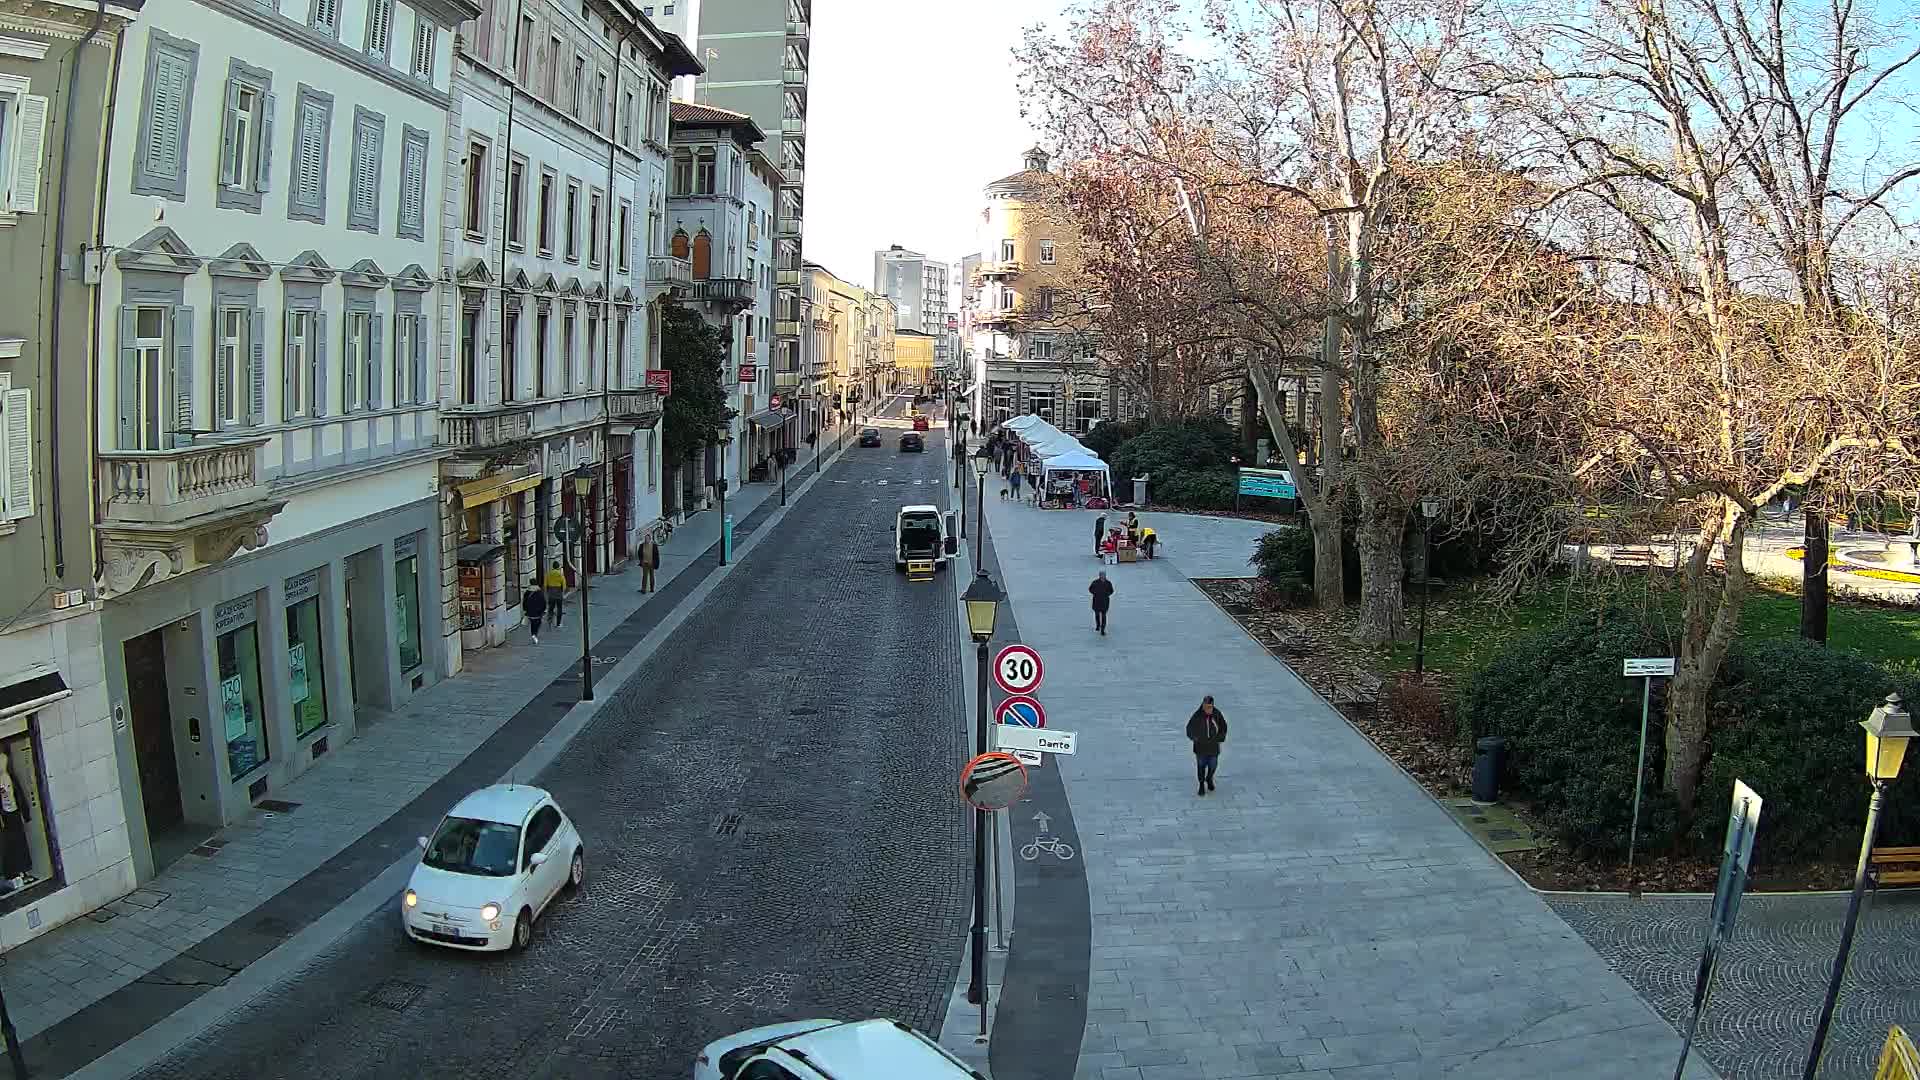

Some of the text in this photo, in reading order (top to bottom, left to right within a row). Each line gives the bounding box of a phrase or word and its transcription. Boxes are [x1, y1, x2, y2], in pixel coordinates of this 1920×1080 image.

[1006, 659, 1033, 680] 30
[222, 678, 240, 700] 130
[1039, 739, 1070, 749] Dante
